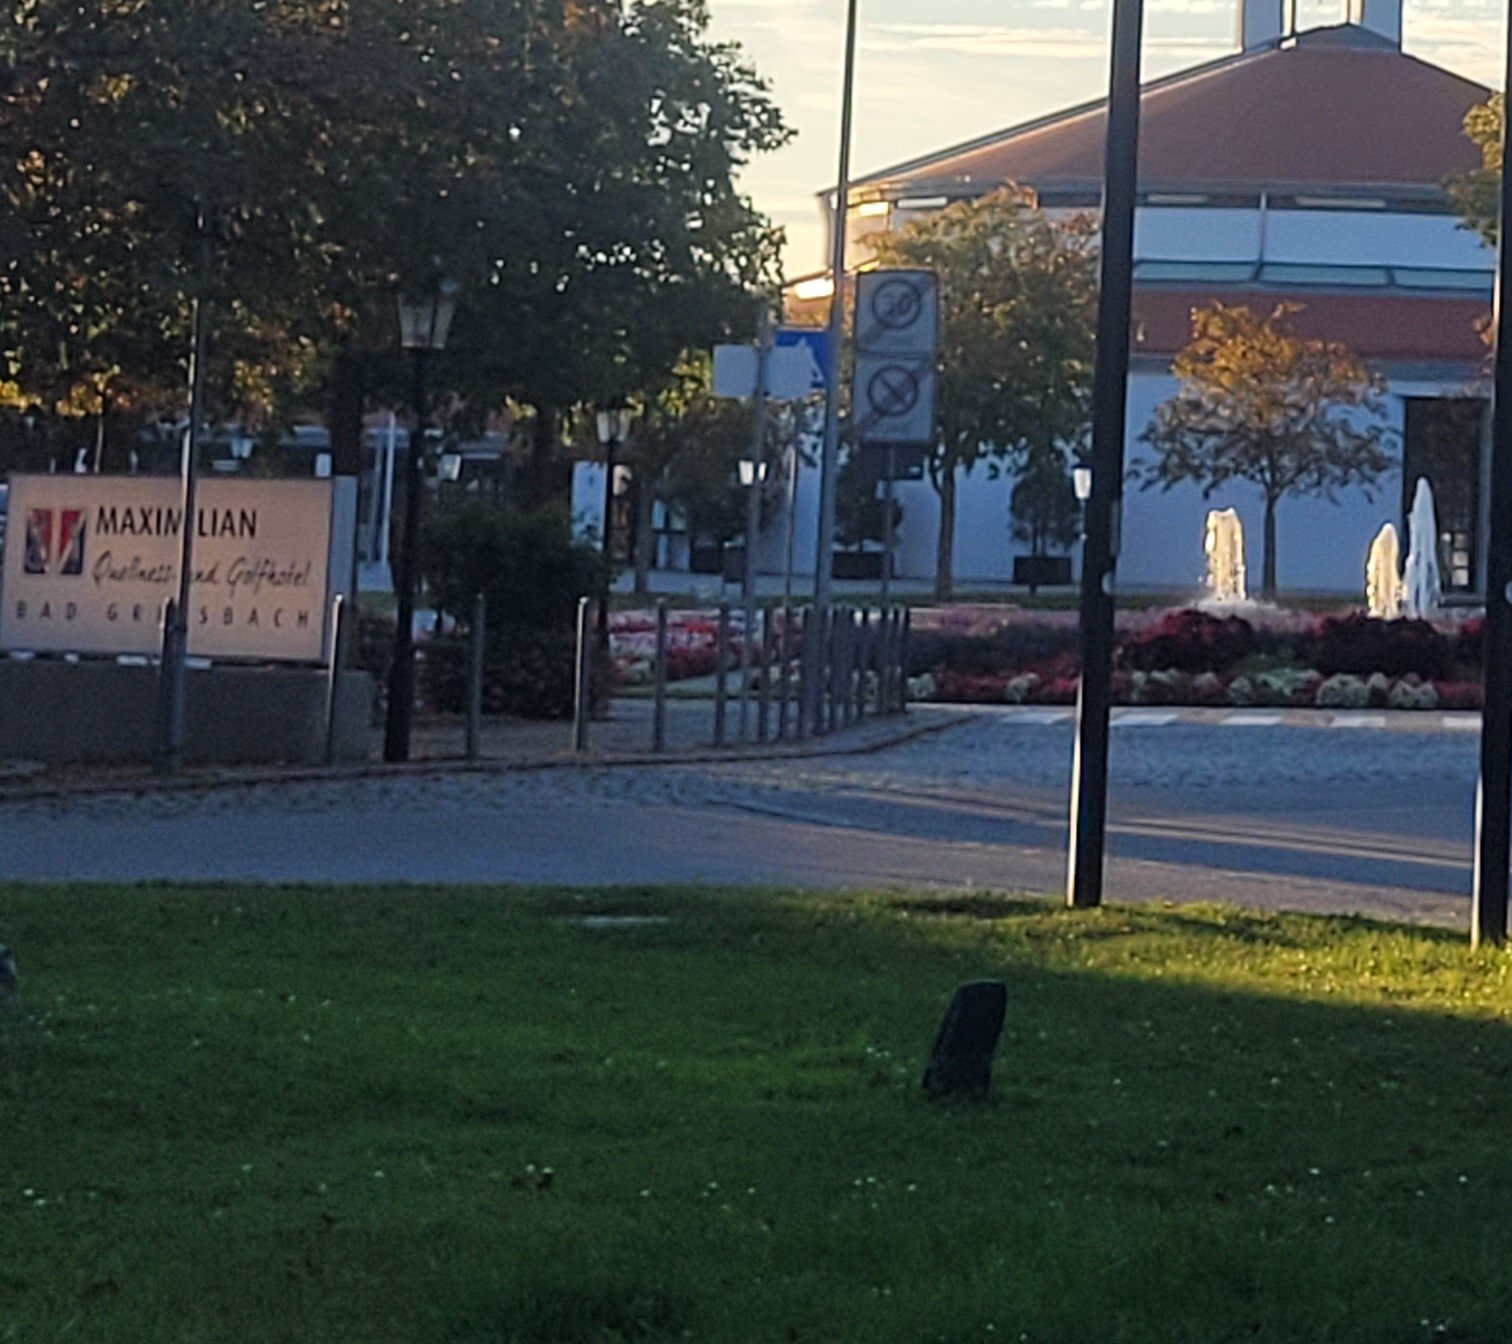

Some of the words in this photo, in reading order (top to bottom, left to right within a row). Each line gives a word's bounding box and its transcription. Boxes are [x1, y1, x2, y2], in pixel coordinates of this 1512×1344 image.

[96, 506, 258, 539] MAXIMLIAN
[226, 556, 312, 599] Golfhotel
[16, 600, 78, 620] BAD
[106, 602, 309, 627] GRISBACH
